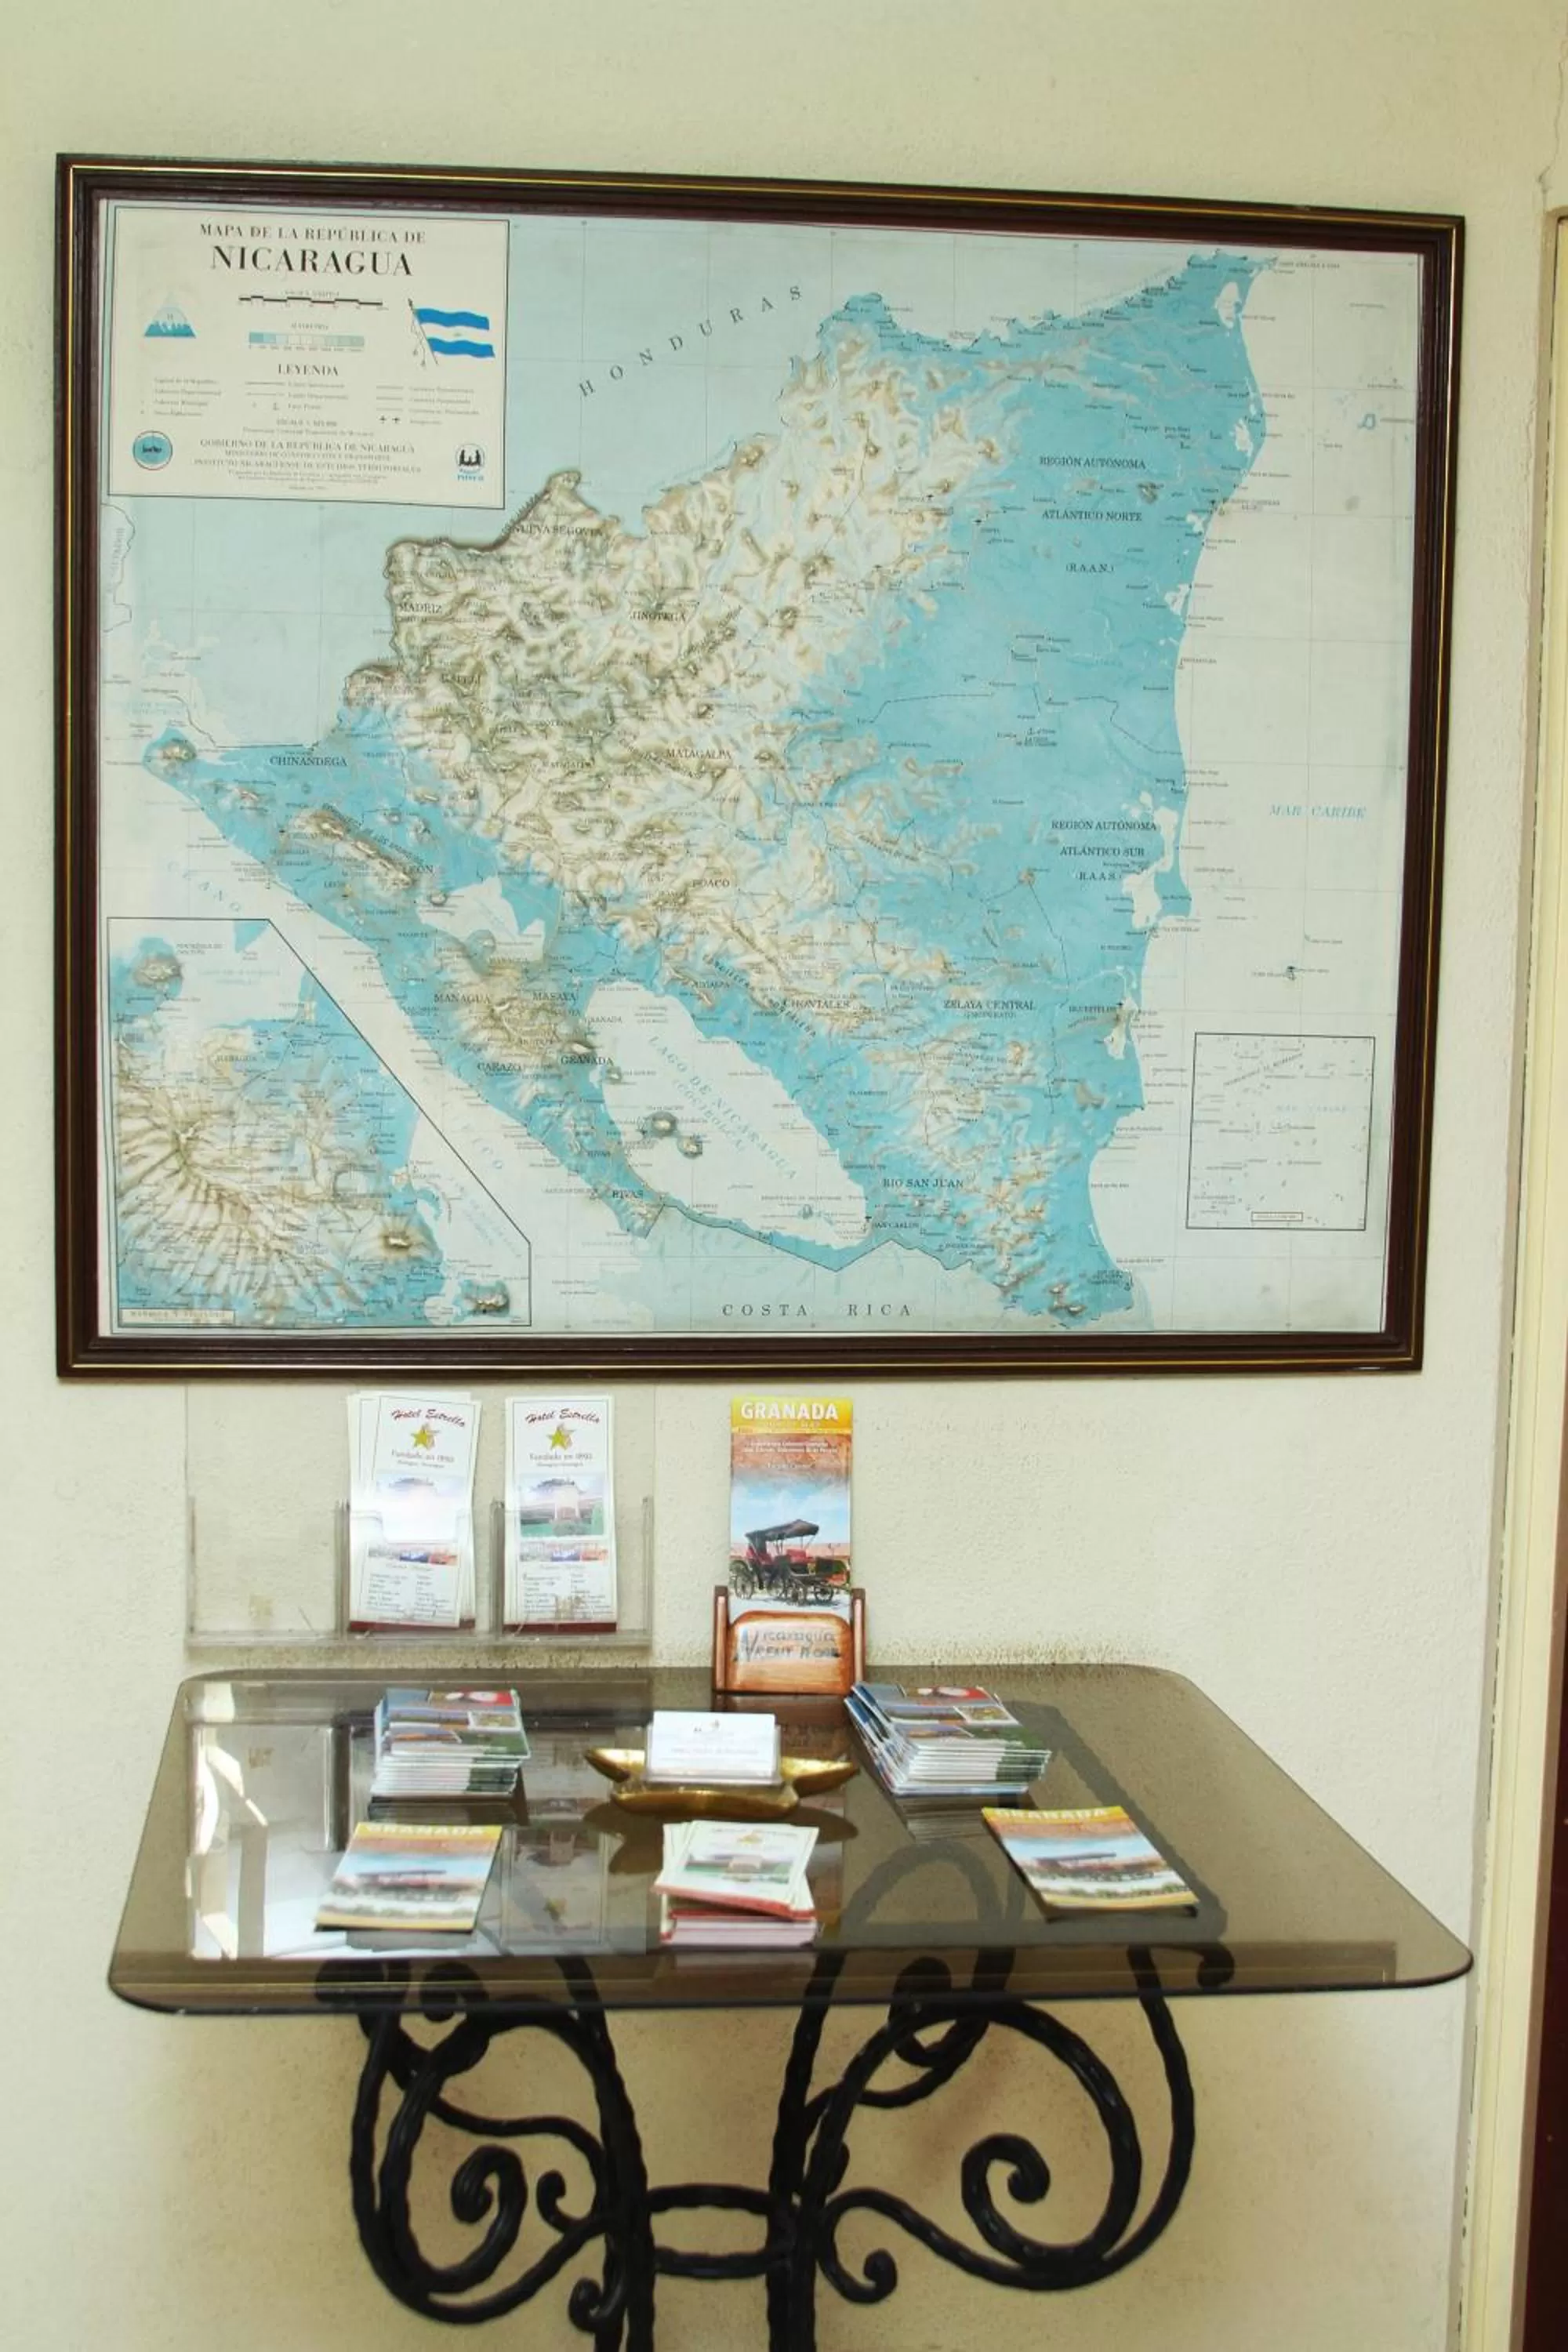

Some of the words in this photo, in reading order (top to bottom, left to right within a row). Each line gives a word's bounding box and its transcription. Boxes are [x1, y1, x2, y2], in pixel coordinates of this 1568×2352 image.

[200, 223, 242, 237] MAPA
[250, 226, 272, 238] DE
[278, 227, 298, 239] LA
[405, 231, 426, 243] DE
[210, 245, 412, 276] NICARAGUA
[579, 285, 802, 397] HONDURAS
[278, 364, 339, 376] LEYENDA
[397, 604, 442, 615] MADRIZ
[270, 756, 349, 767] CHINANDEGA
[434, 993, 491, 1004] MANAGUA
[533, 993, 576, 1003] MASAYA
[477, 1062, 523, 1073] CARAZO
[561, 1056, 615, 1067] GRANADA
[906, 1178, 930, 1189] SAN
[932, 1178, 964, 1189] JUAN
[722, 1303, 808, 1317] COSTA
[848, 1304, 911, 1317] RICA
[390, 1409, 422, 1421] Hotel
[740, 1401, 839, 1421] GRANADA
[525, 1411, 556, 1424] Hotel
